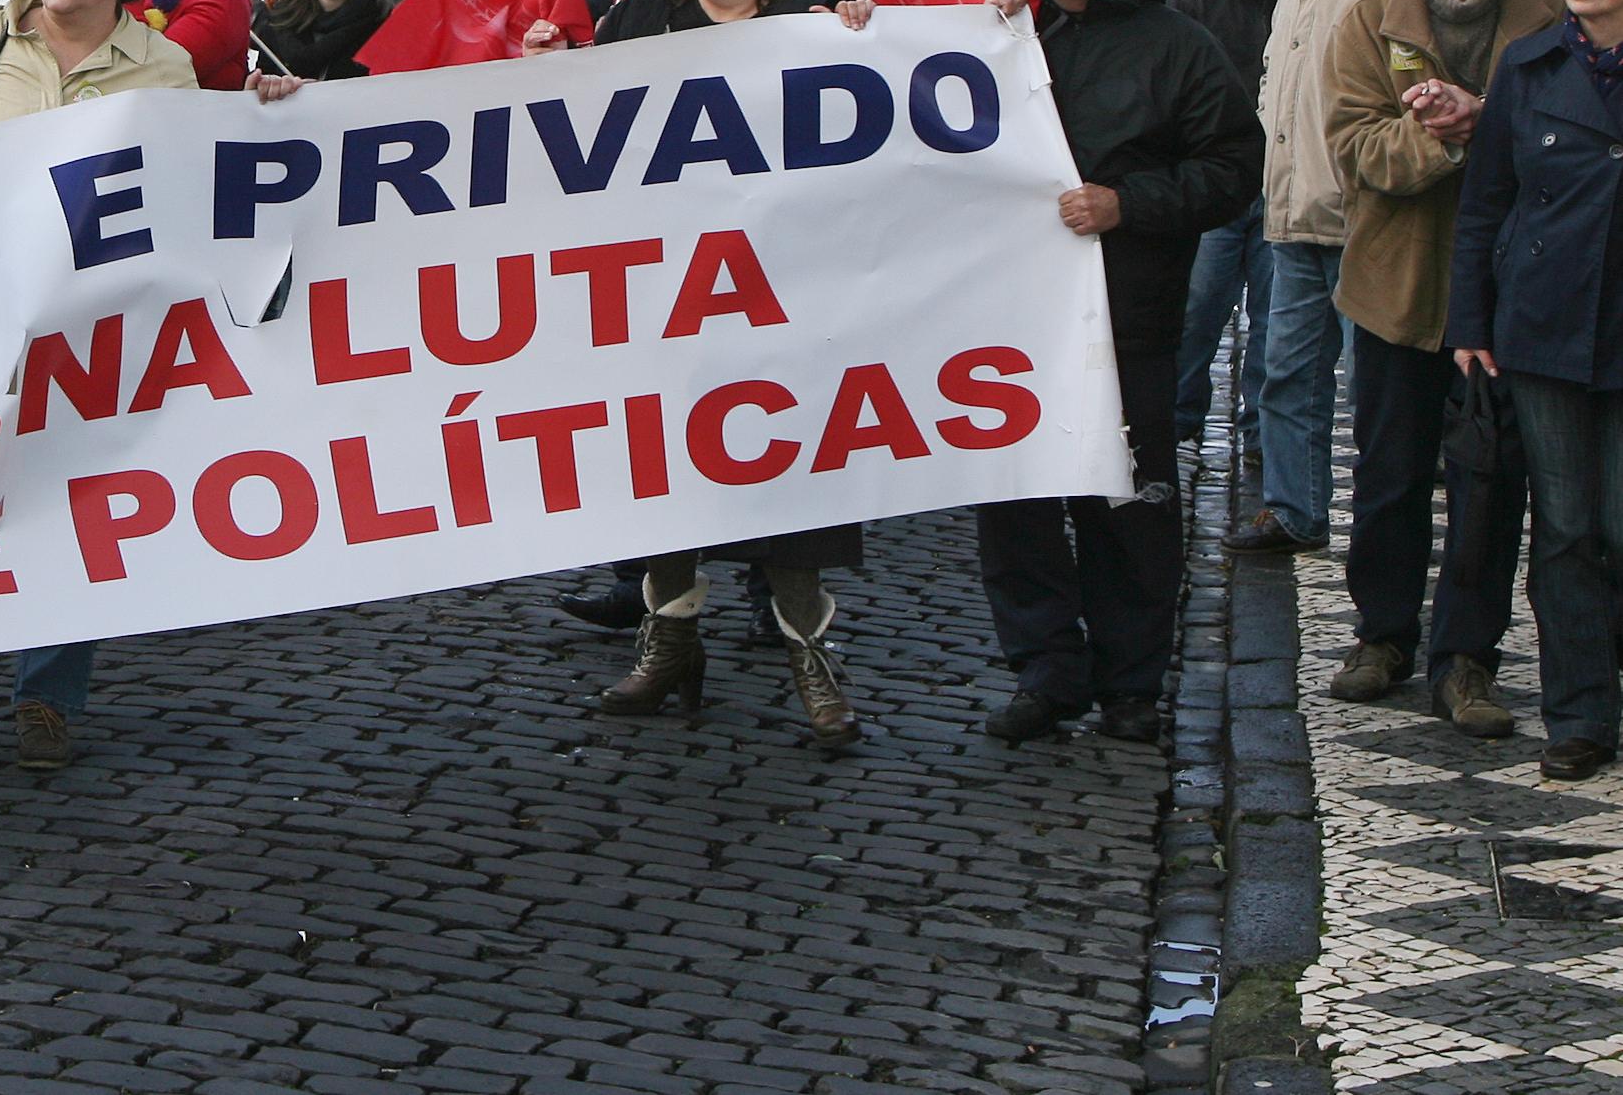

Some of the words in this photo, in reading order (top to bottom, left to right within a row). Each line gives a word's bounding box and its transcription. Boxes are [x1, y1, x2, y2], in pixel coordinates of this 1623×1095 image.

[48, 144, 154, 269] E
[214, 51, 1000, 239] PRIVADO
[16, 298, 253, 436] NA
[309, 230, 789, 386] LUTA
[68, 346, 1042, 583] POLÍTICAS
